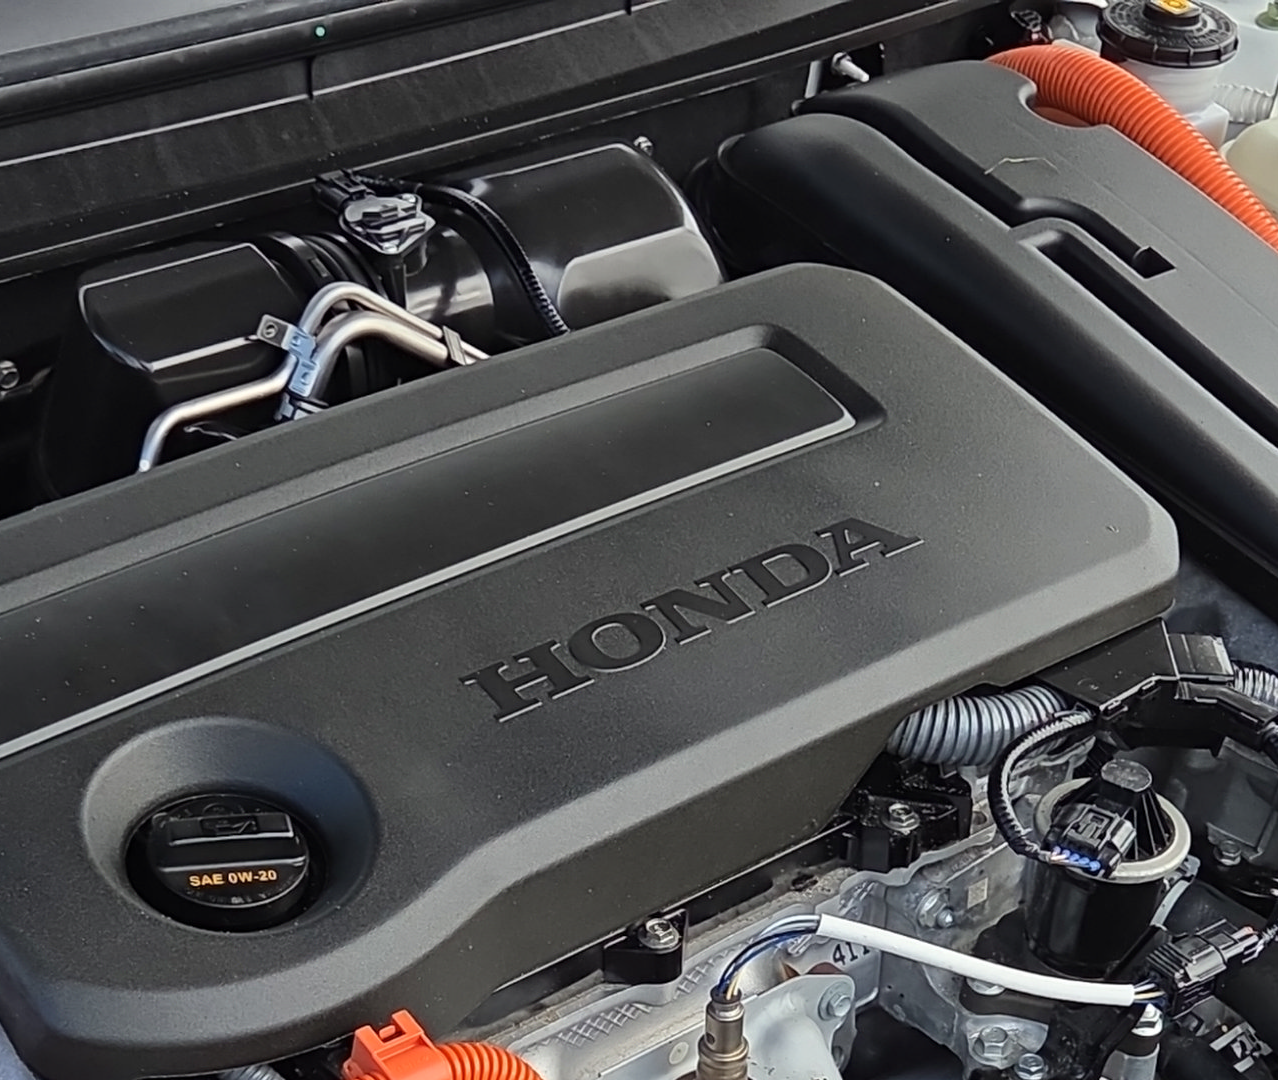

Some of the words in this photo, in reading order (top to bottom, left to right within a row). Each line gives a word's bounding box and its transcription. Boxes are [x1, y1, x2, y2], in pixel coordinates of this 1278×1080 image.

[459, 517, 925, 723] HONDA
[189, 872, 225, 888] SAE
[228, 869, 278, 885] 0W-20
